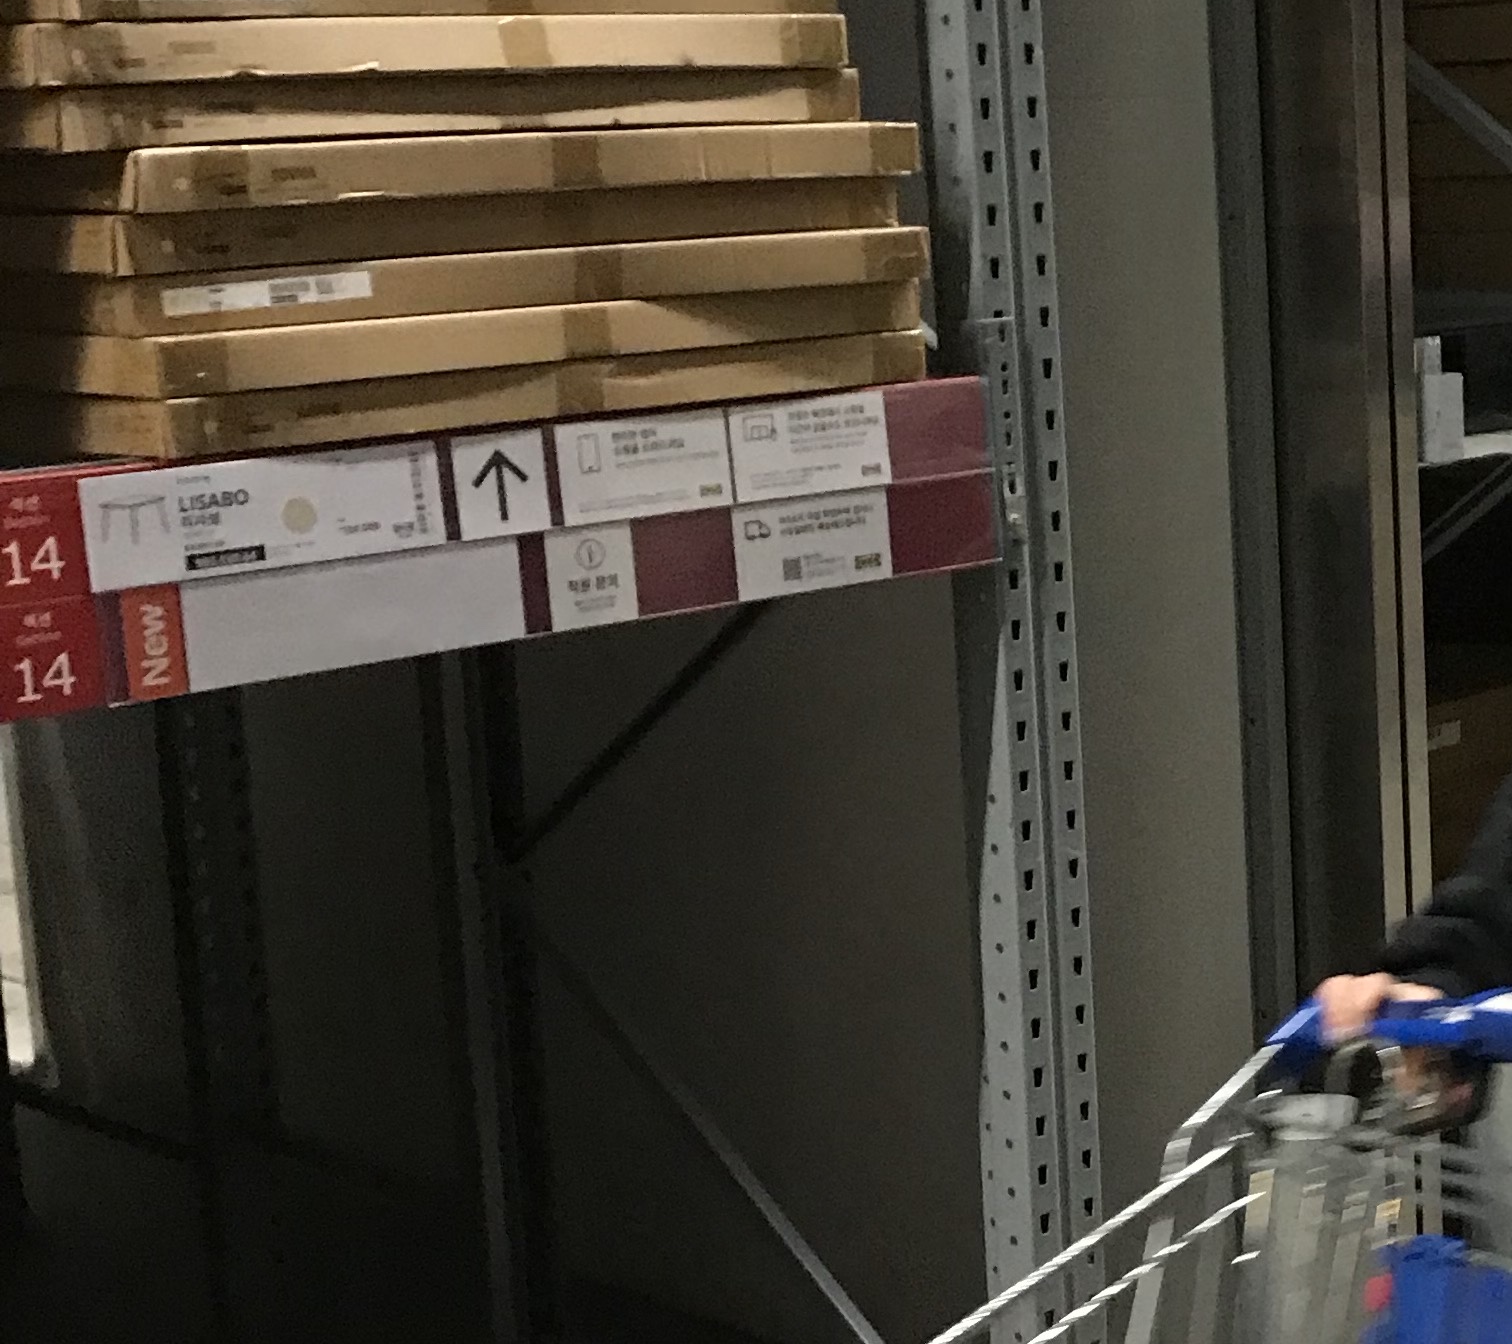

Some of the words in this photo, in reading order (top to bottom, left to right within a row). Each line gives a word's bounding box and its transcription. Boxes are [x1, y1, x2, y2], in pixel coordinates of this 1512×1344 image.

[177, 488, 250, 512] LISABO
[1, 535, 67, 586] 14
[140, 603, 173, 686] New
[13, 650, 77, 703] 14
